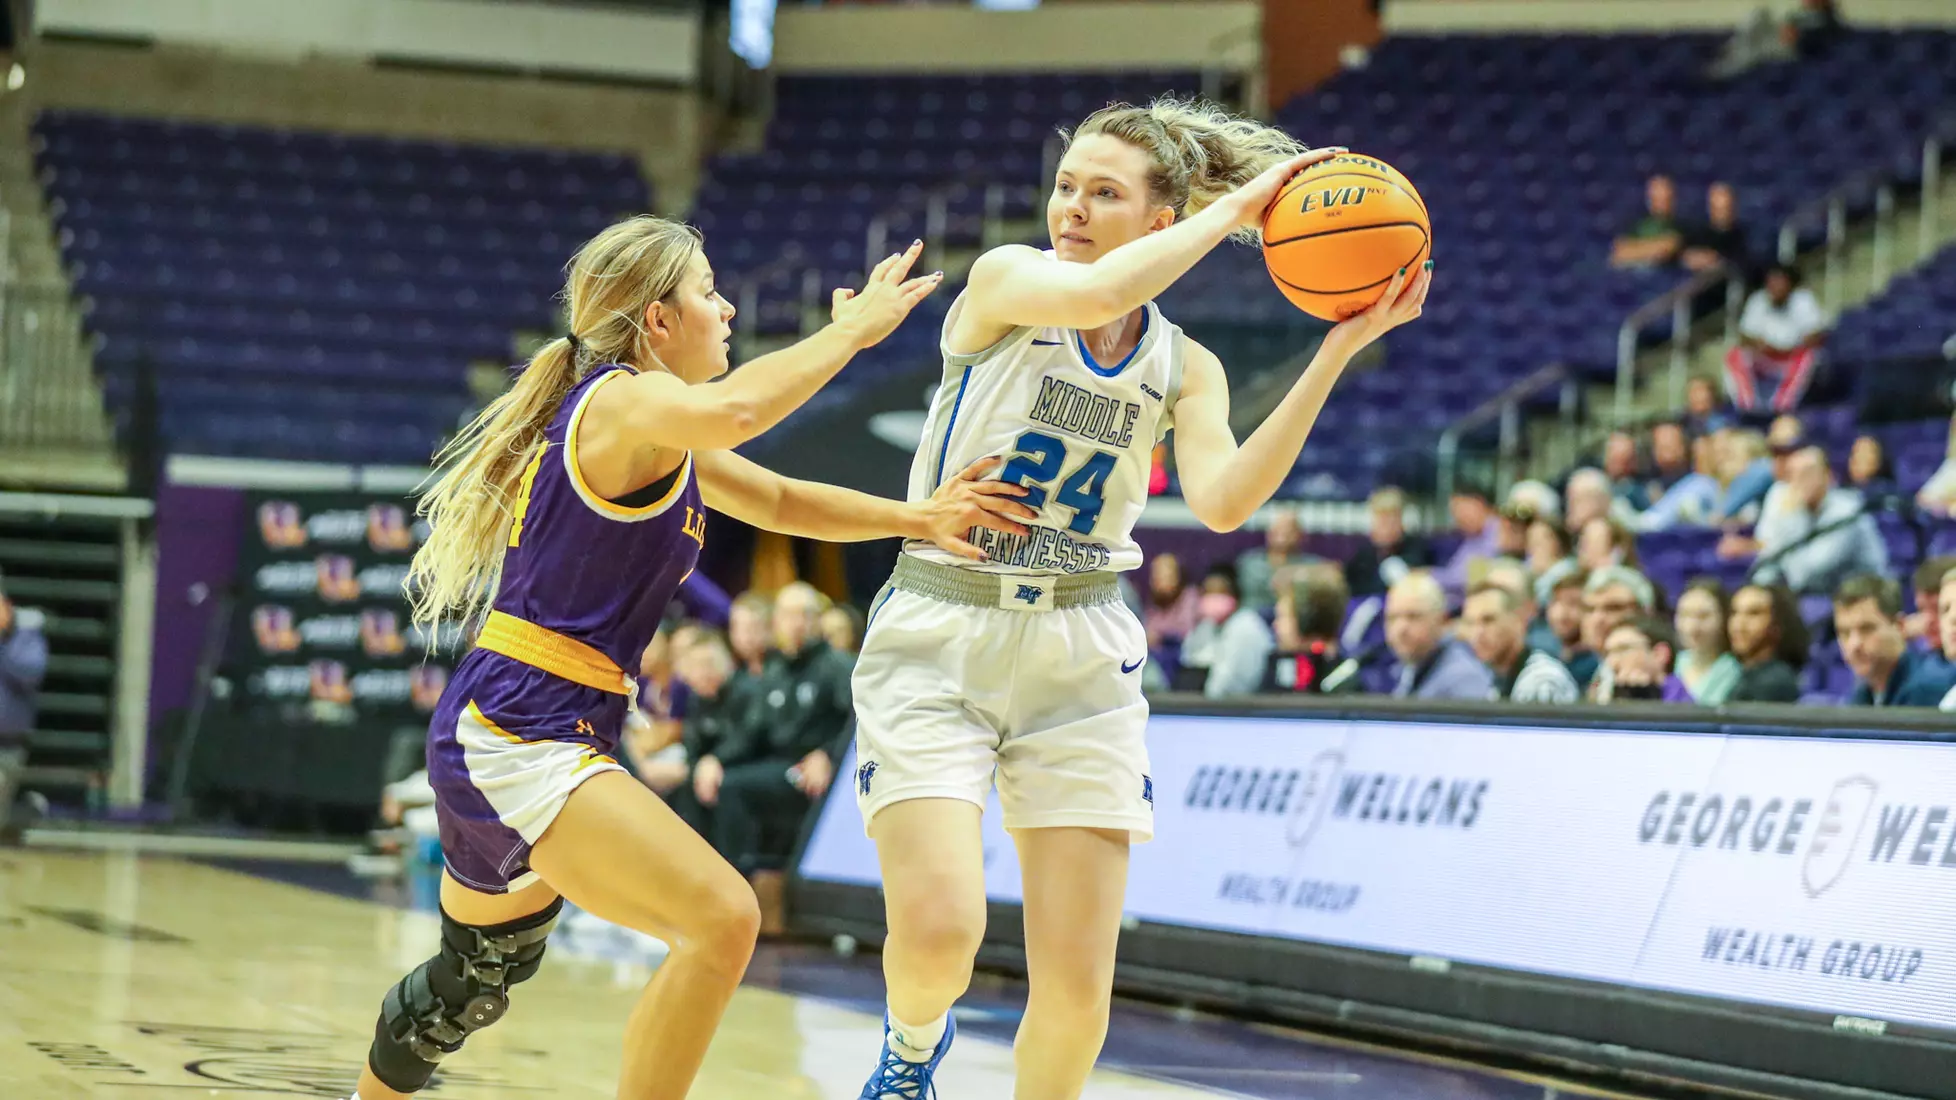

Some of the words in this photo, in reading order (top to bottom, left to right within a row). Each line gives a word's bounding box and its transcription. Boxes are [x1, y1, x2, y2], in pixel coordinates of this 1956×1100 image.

[1301, 186, 1367, 213] EVO
[1029, 375, 1140, 449] MIDDLE
[1000, 428, 1119, 536] 24
[1184, 765, 1301, 815] GEORGE
[1331, 772, 1491, 828] WELLONS
[1637, 790, 1813, 855] GEORGE
[1701, 925, 1814, 971] WEALTH
[1819, 938, 1923, 983] GROUP
